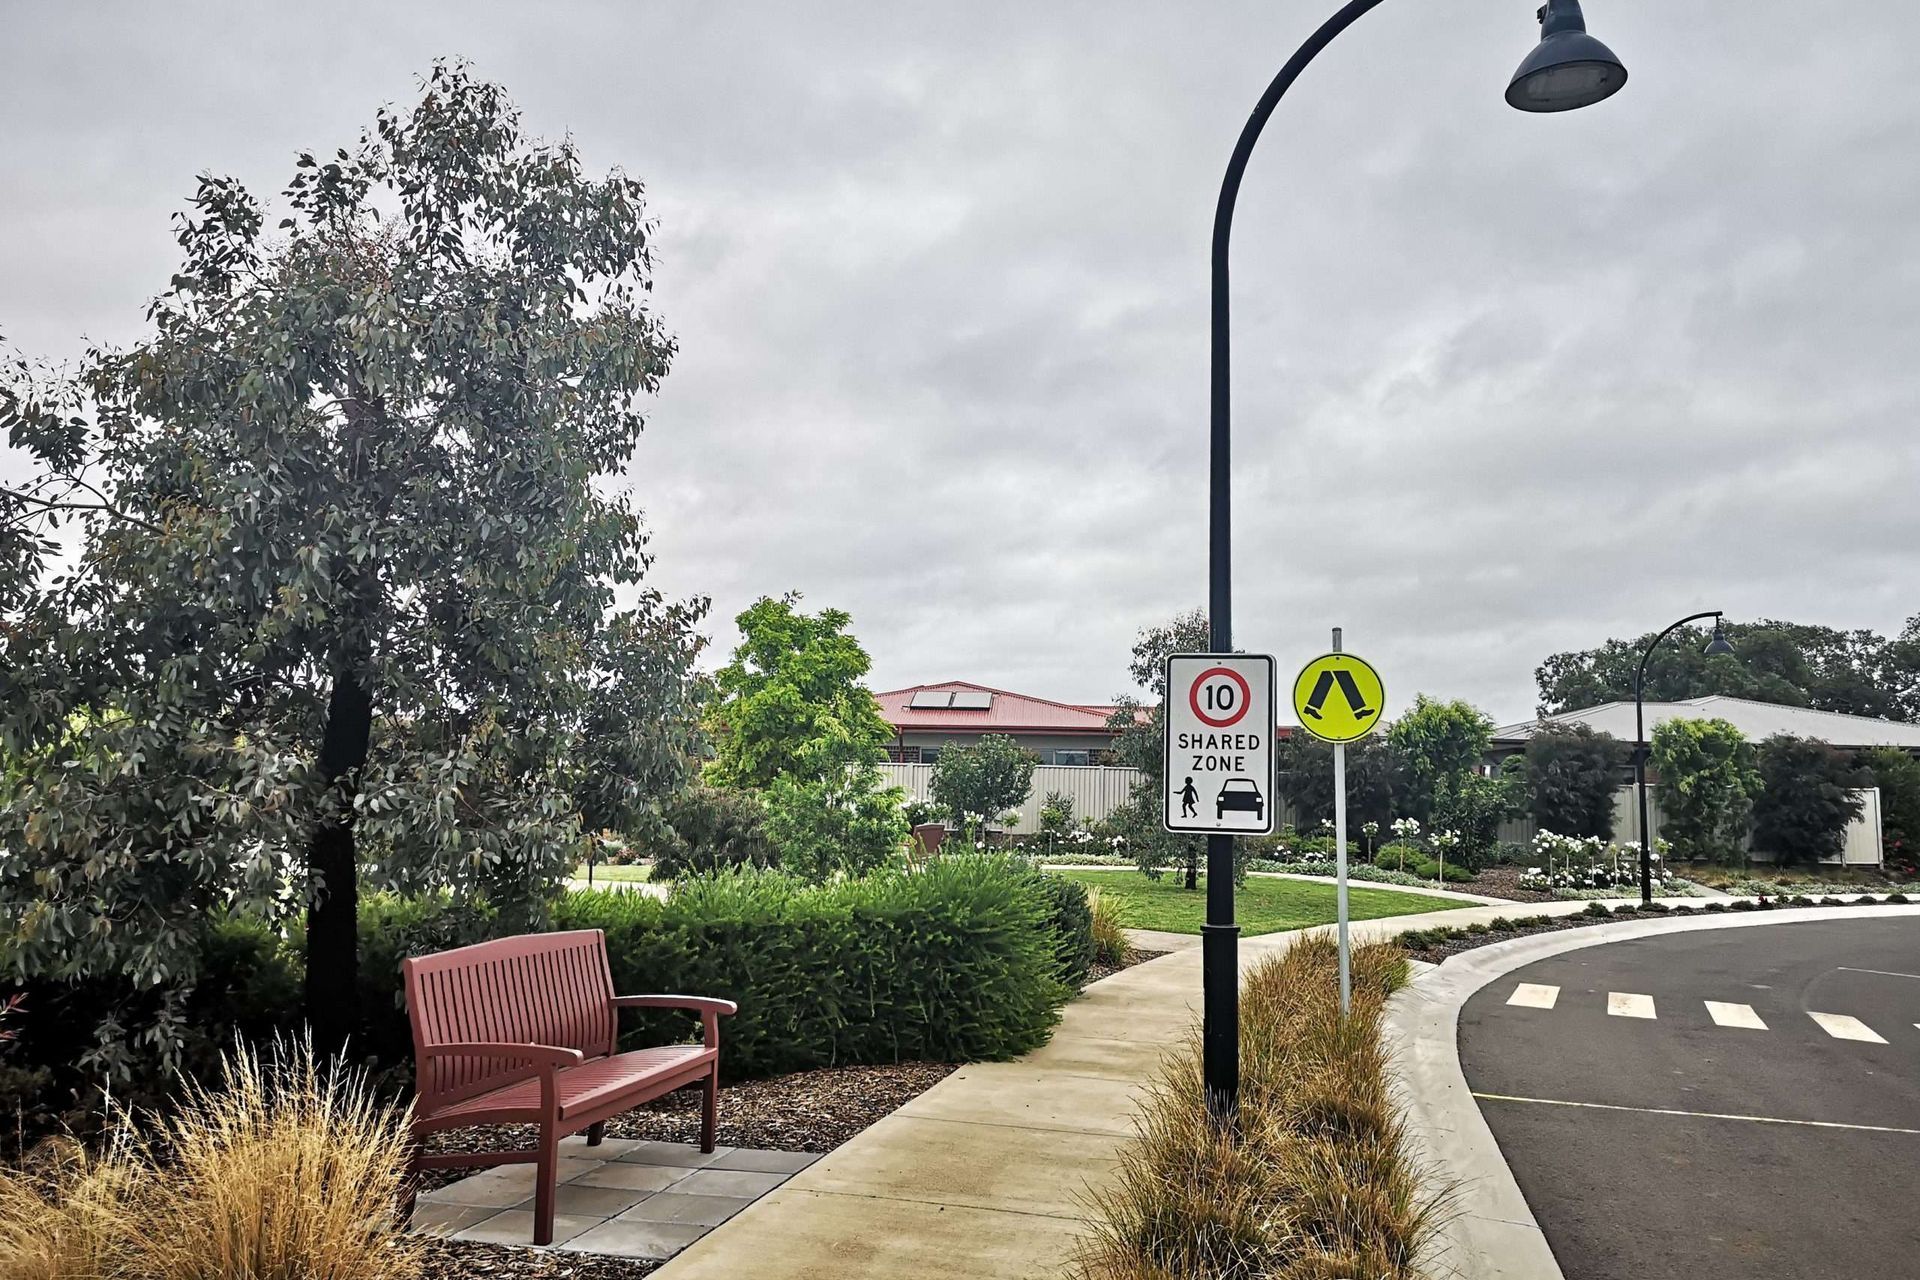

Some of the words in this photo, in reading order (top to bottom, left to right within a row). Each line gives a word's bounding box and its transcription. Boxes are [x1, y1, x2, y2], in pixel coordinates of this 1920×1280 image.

[1205, 684, 1235, 711] 10
[1178, 733, 1260, 750] SHARED
[1192, 755, 1246, 772] ZONE
